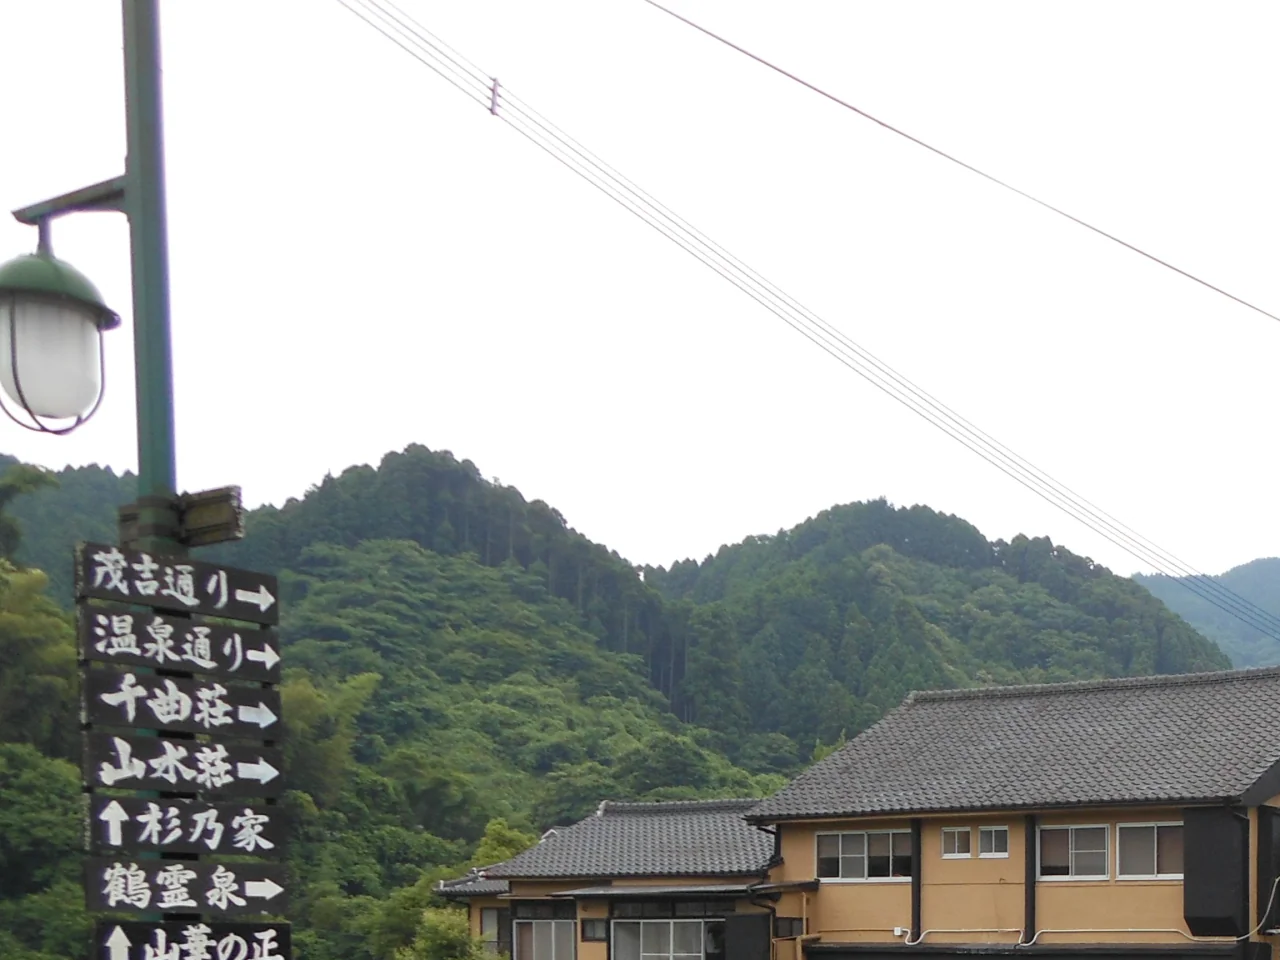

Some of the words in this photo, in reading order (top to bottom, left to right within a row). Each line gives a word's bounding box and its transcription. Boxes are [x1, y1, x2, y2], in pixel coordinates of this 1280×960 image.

[93, 547, 228, 609] 茂吉通り
[94, 614, 243, 672] 温泉通り
[100, 673, 234, 729] 千曲荘
[99, 736, 235, 789] 山水荘
[136, 802, 275, 852] 杉乃家
[102, 862, 247, 910] 鶴霊泉
